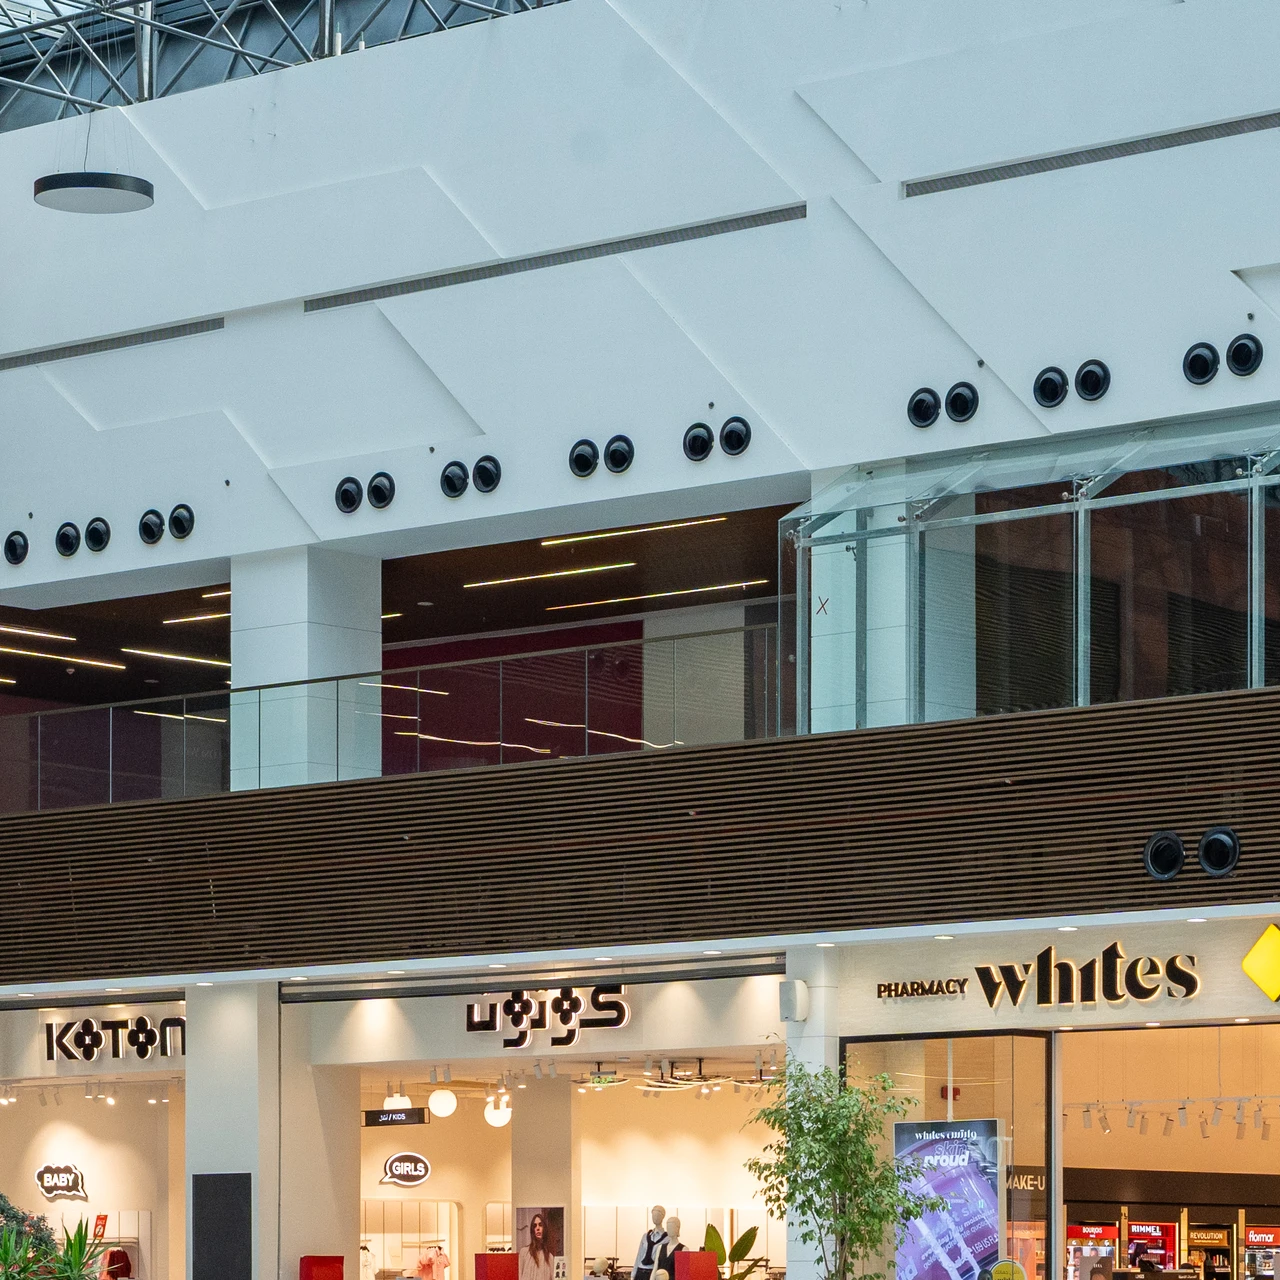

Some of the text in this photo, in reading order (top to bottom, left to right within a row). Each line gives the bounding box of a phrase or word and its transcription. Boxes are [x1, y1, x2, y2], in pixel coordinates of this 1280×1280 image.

[975, 941, 1198, 1008] whites
[877, 978, 969, 999] PHARMACY
[46, 1016, 187, 1061] KOTON
[915, 1131, 945, 1140] whites
[946, 1129, 977, 1140] وايتس
[934, 1140, 968, 1157] skin
[392, 1161, 425, 1176] GIRLS
[43, 1173, 75, 1187] BABY
[1082, 1226, 1103, 1234] BOURJOIS
[1131, 1225, 1162, 1233] RIMMEL
[1189, 1232, 1223, 1240] REVOLUTION
[1248, 1230, 1275, 1242] flormar
